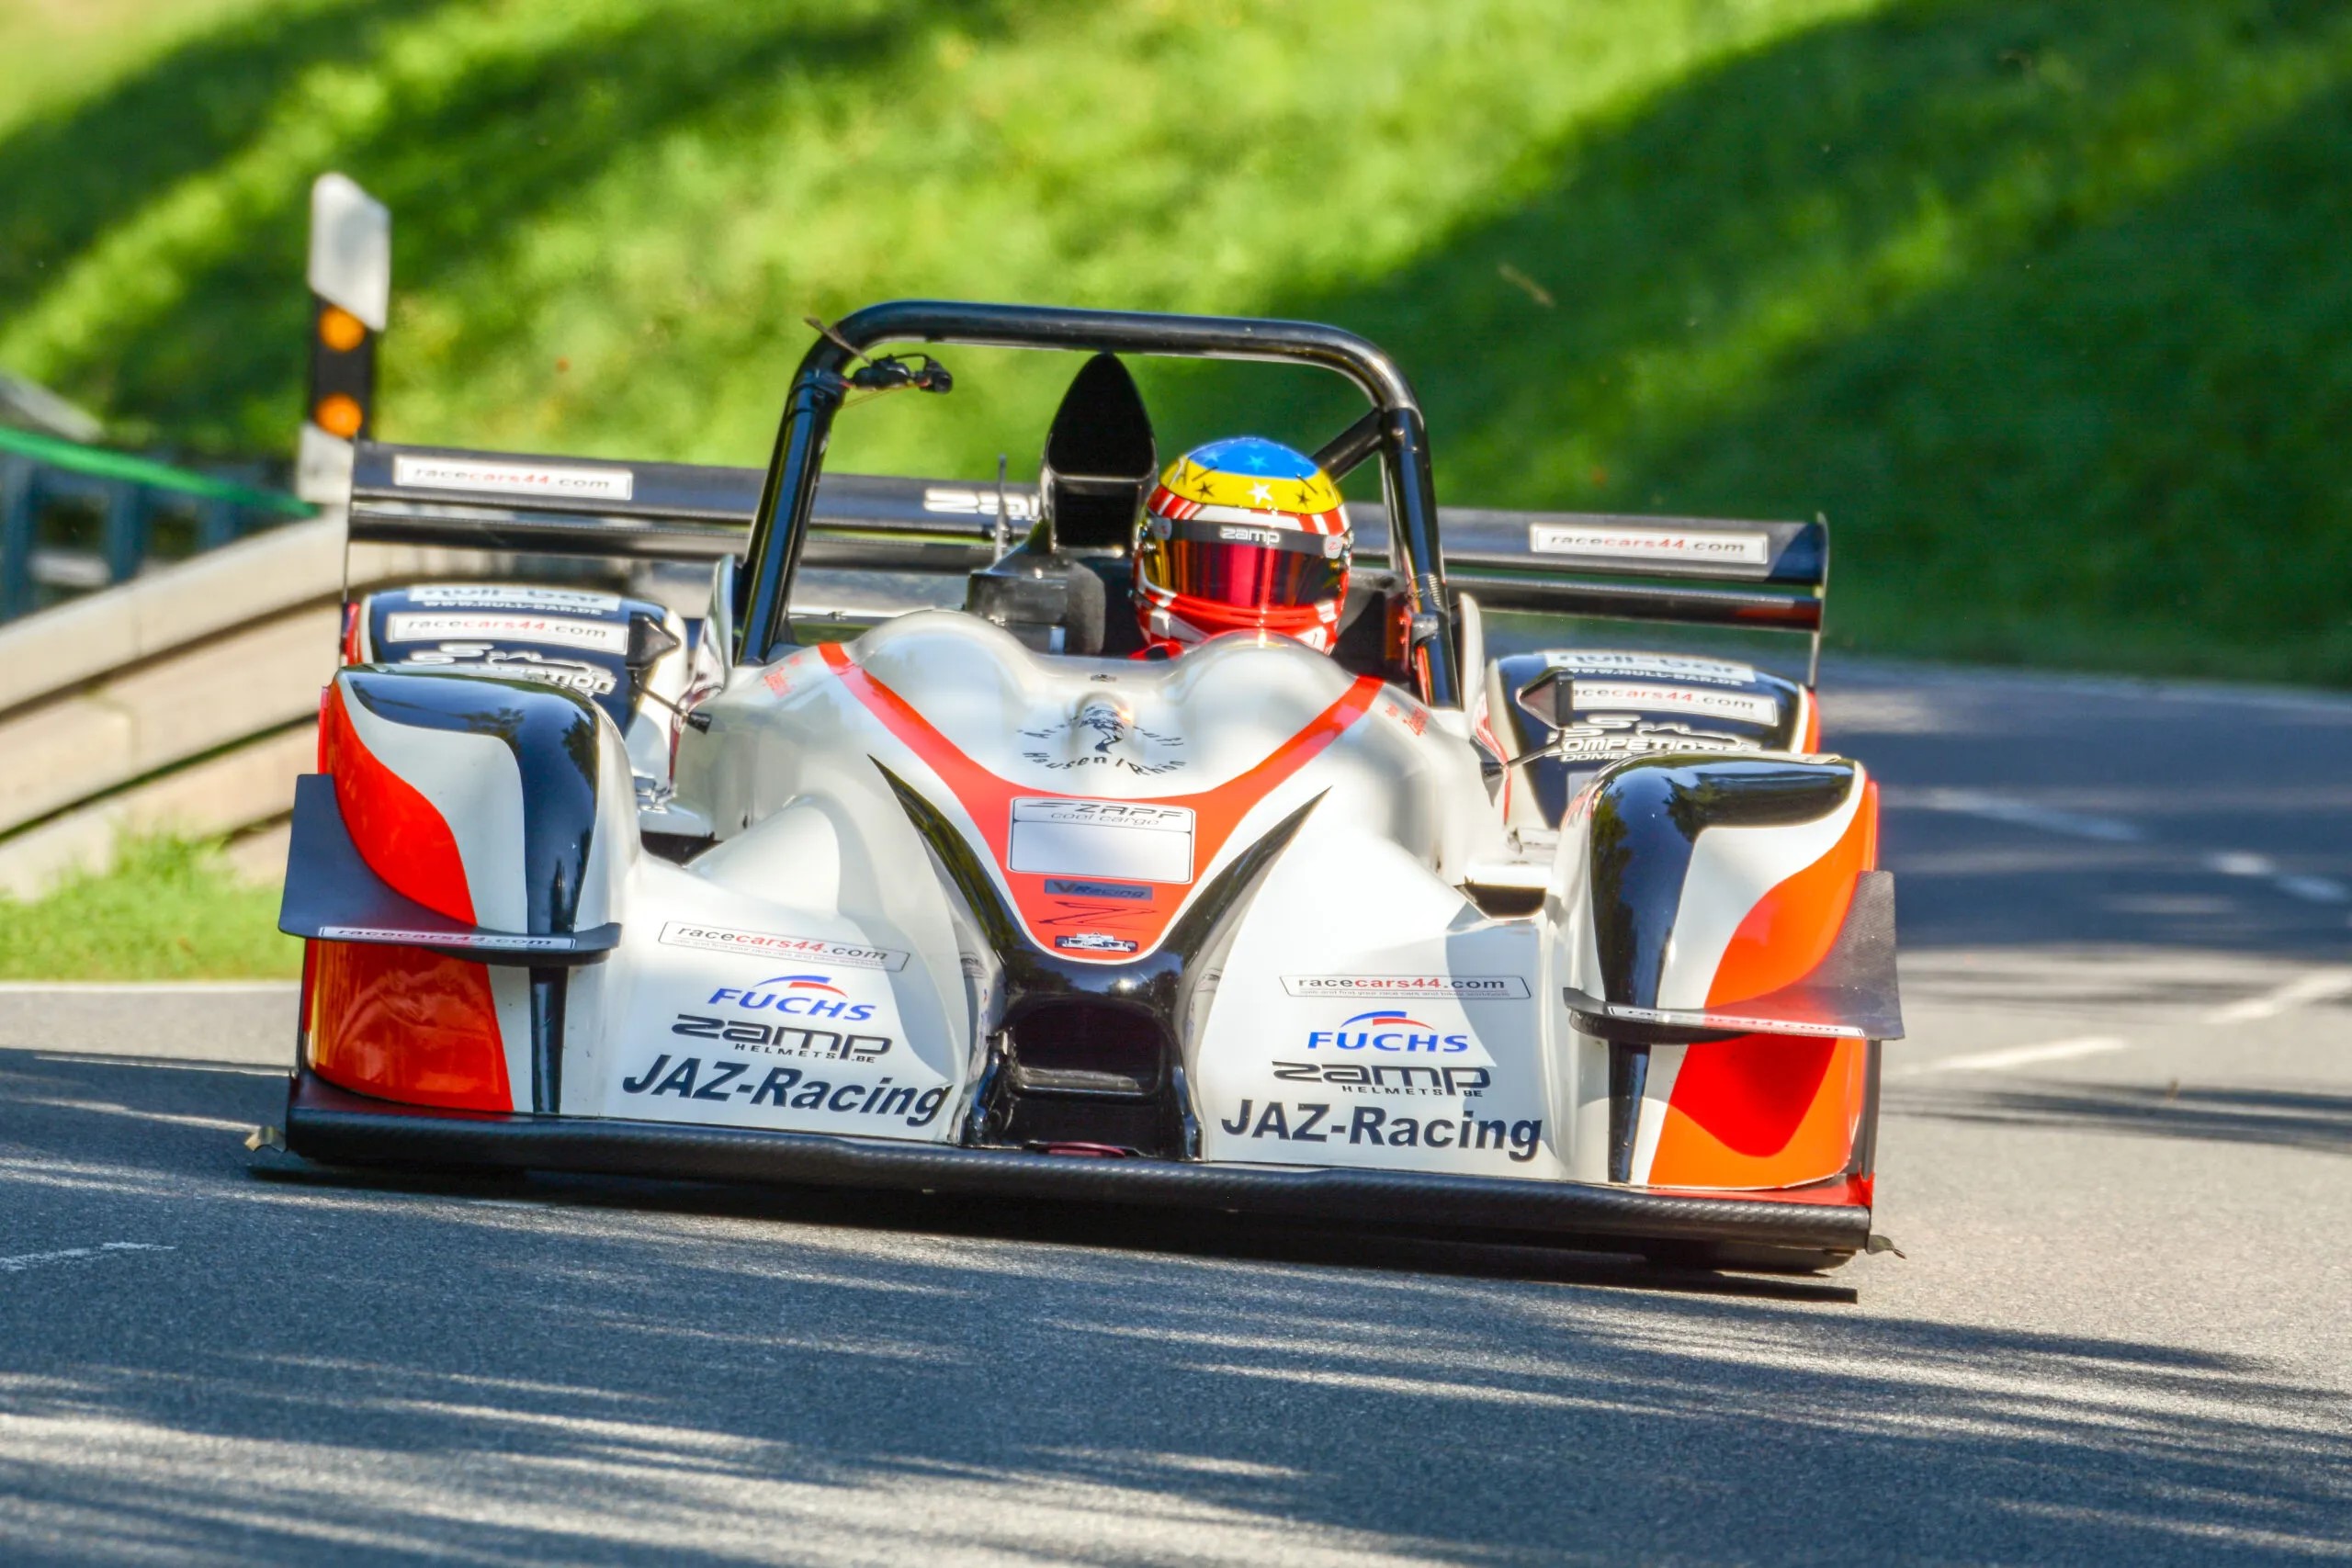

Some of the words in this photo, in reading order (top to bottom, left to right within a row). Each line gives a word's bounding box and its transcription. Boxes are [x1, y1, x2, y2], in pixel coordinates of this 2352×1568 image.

[415, 467, 610, 490] racecars44.com
[1220, 526, 1281, 545] zamp
[1551, 534, 1746, 553] racecars44.com
[408, 619, 608, 639] racecars44.com
[1022, 751, 1107, 770] Hausen
[1050, 812, 1094, 821] cool
[1099, 815, 1159, 826] cargo
[1075, 803, 1183, 818] ZAPF
[337, 929, 553, 946] racecars44.com
[676, 925, 888, 961] racecars44.com
[1298, 977, 1505, 989] racecars44.com
[707, 987, 876, 1021] FUCHS
[671, 1013, 893, 1061] zamp
[1306, 1031, 1469, 1053] FUCHS
[734, 1043, 836, 1059] HELMETS
[1272, 1059, 1492, 1096] zamp
[622, 1054, 955, 1128] JAZ-Racing
[1341, 1085, 1443, 1096] HELMETS
[1221, 1099, 1543, 1163] JAZ-Racing
